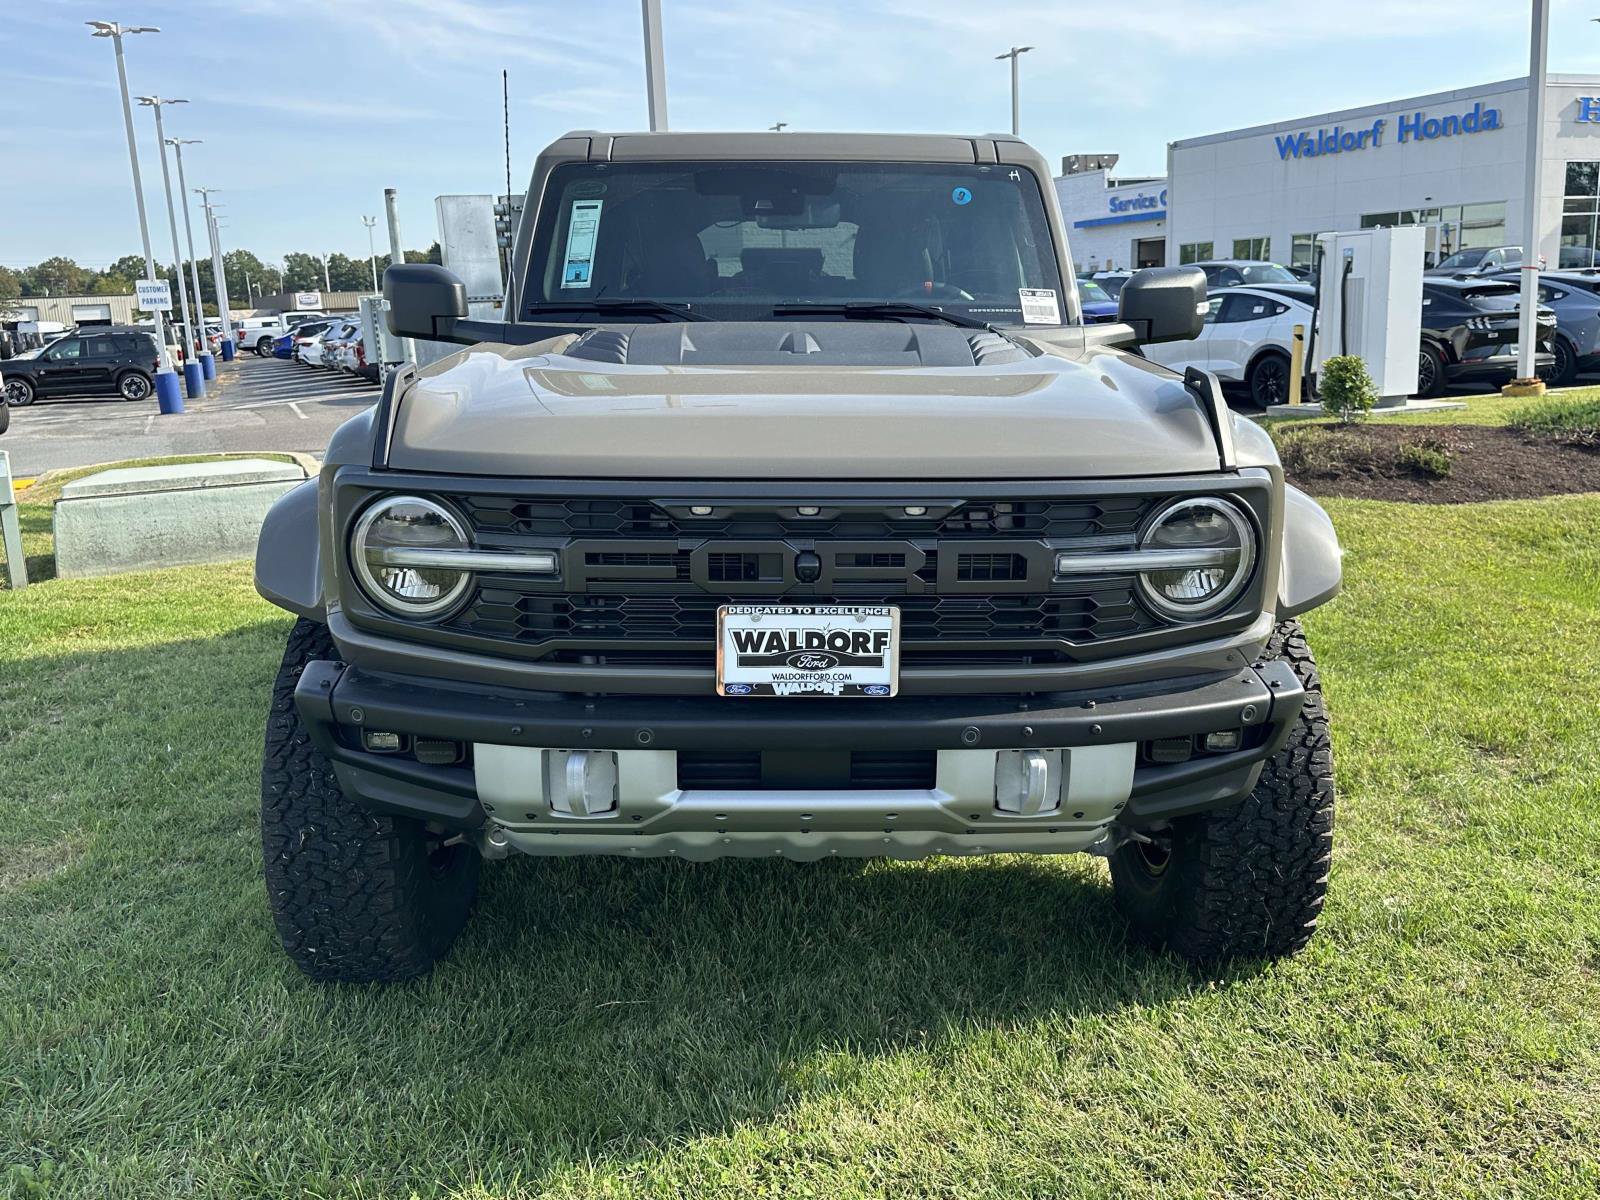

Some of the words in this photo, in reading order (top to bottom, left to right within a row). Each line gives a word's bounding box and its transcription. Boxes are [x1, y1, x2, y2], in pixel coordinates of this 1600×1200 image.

[1275, 119, 1387, 160] Waldorf
[1398, 102, 1503, 143] Honda
[1109, 193, 1158, 213] Service
[565, 539, 1053, 595] FORD
[728, 607, 793, 615] DEDICATED
[795, 607, 812, 615] TO
[814, 607, 889, 616] EXCELLENCE
[730, 629, 890, 655] WALDORF
[796, 653, 829, 669] Ford
[771, 672, 852, 681] WALDORFFORD.COM
[771, 681, 844, 696] WALDORF
